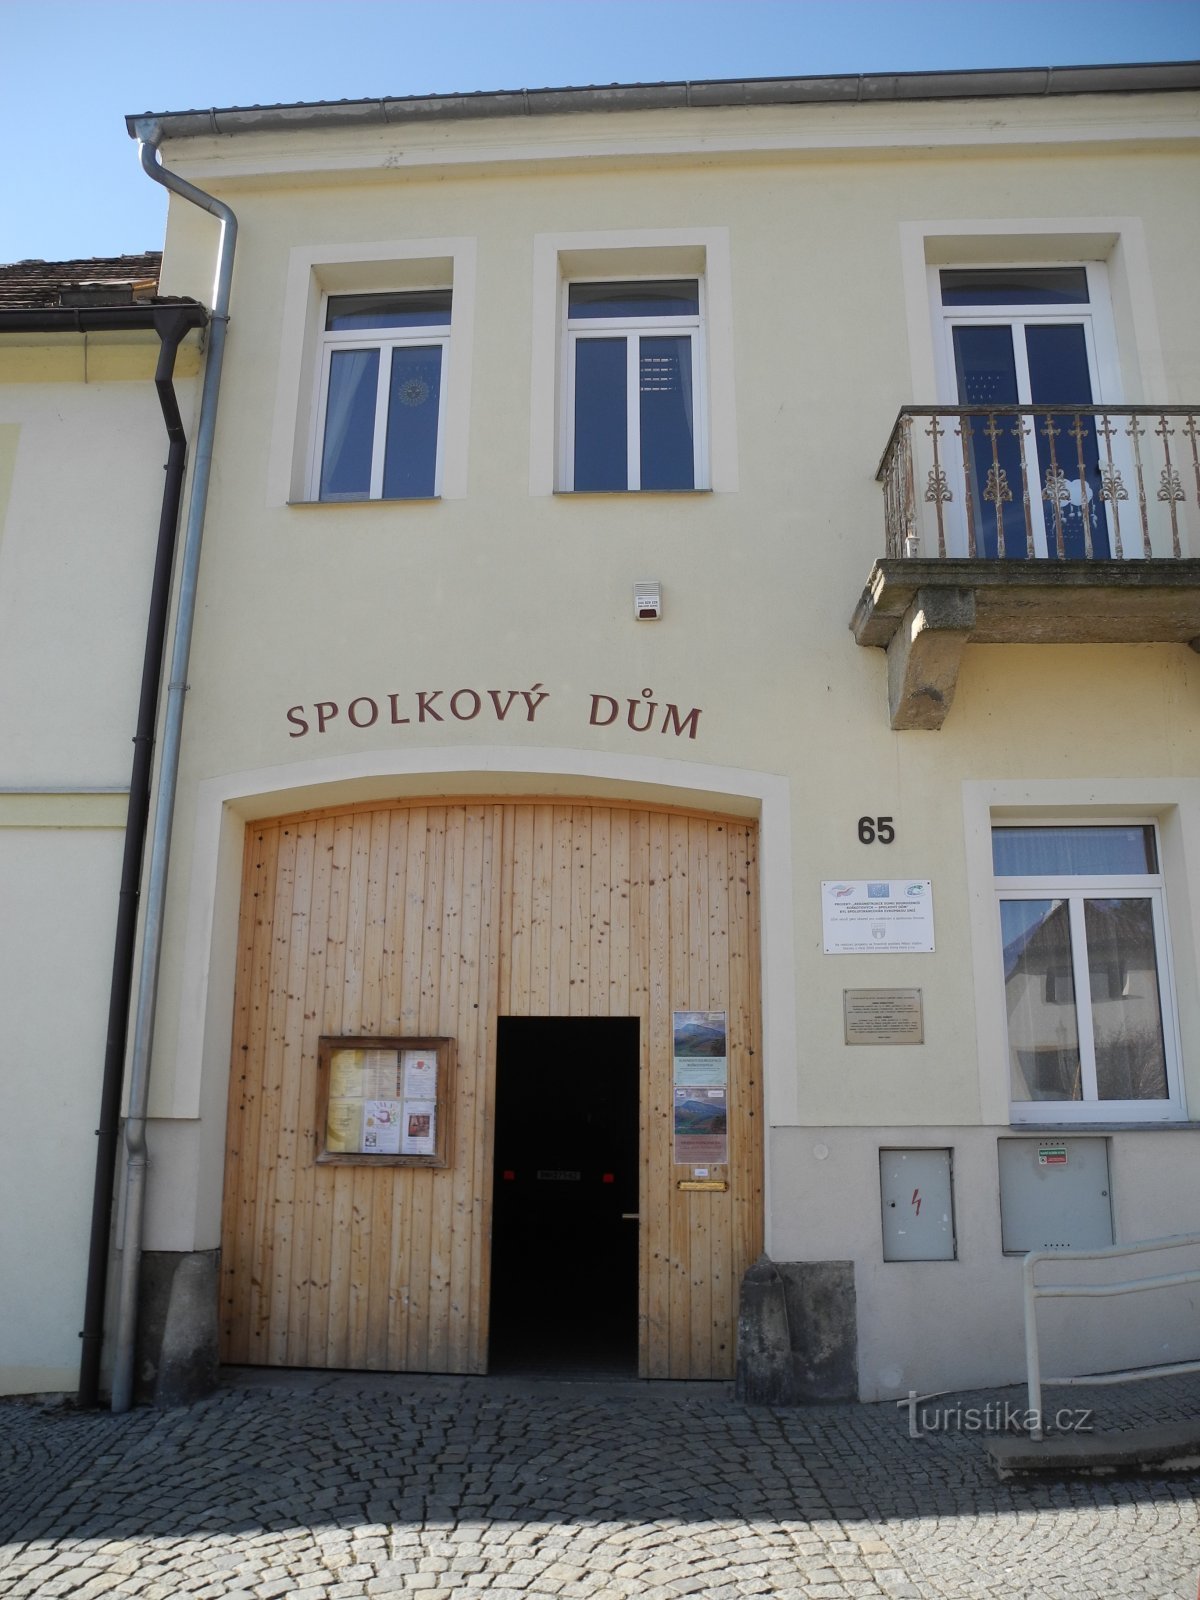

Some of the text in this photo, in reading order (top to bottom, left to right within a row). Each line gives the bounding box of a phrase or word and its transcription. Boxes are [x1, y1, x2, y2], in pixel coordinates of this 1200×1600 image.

[286, 683, 703, 740] SPOLKOVÝ DŮM
[858, 816, 895, 845] 65
